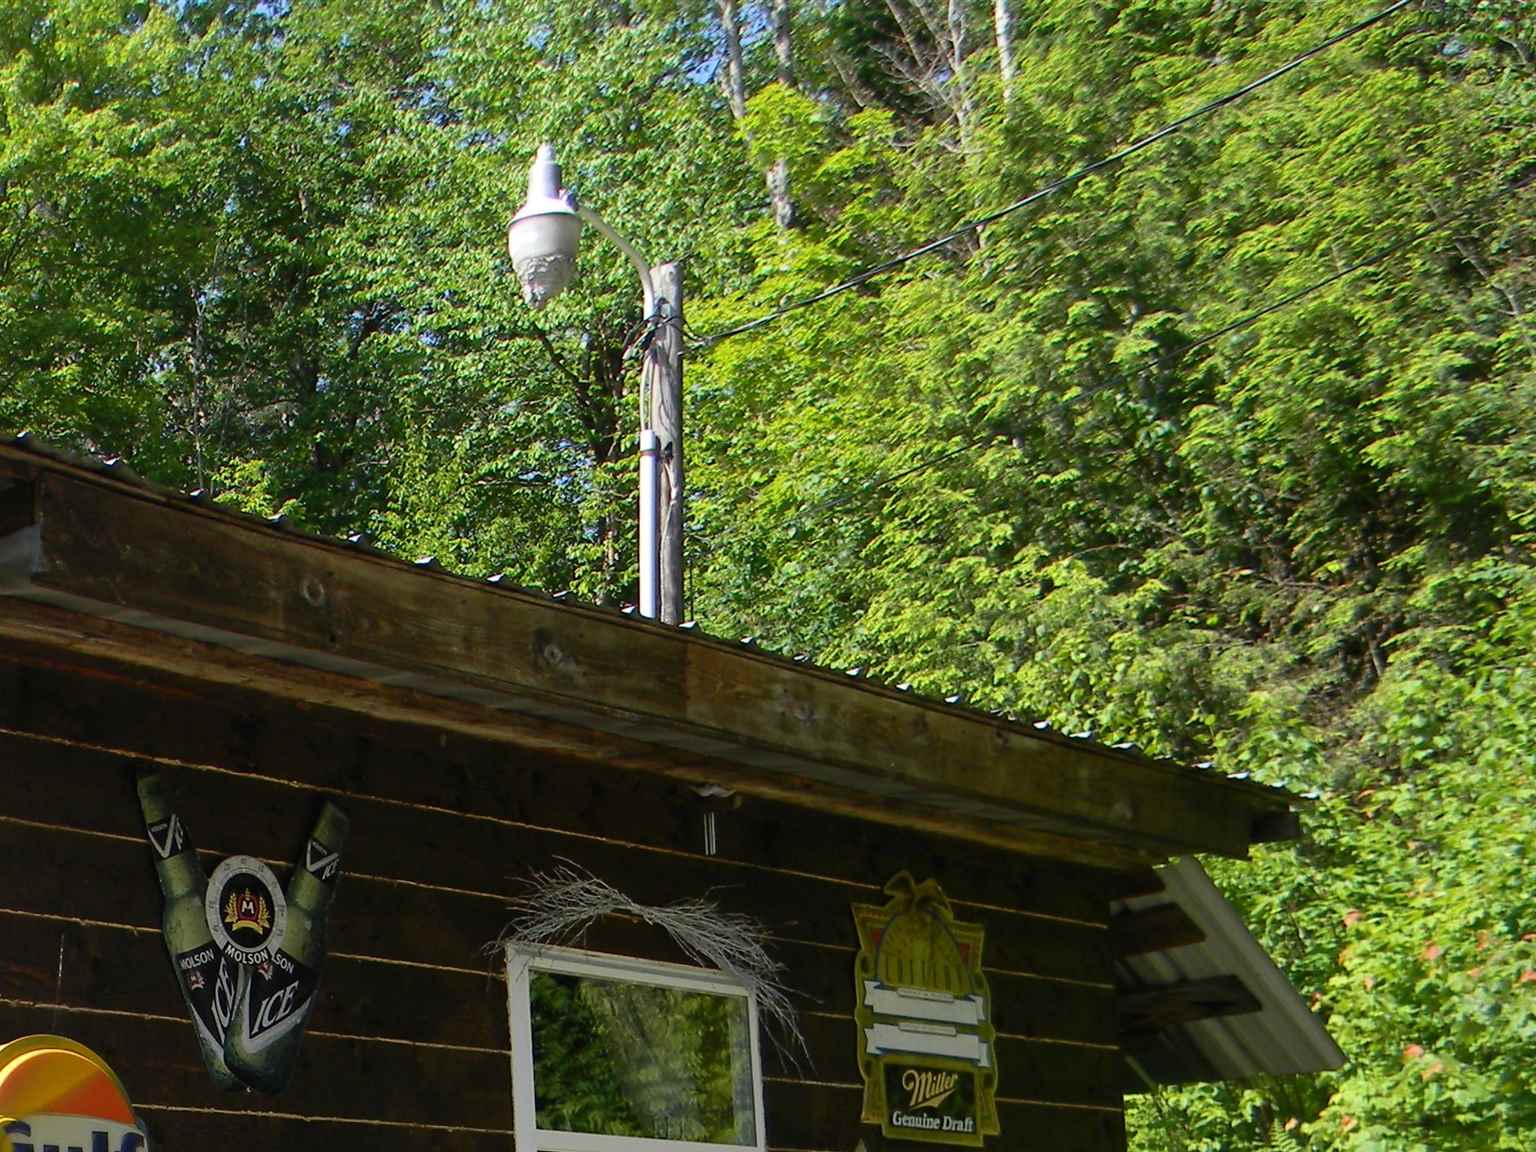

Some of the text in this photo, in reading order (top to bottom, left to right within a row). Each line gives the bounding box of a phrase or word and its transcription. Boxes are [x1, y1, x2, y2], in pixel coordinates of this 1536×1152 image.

[224, 945, 269, 966] MOLSON
[271, 950, 295, 976] LSON
[250, 980, 300, 1036] ICE
[901, 1069, 960, 1109] Miller
[892, 1111, 974, 1132] Genuine Draft
